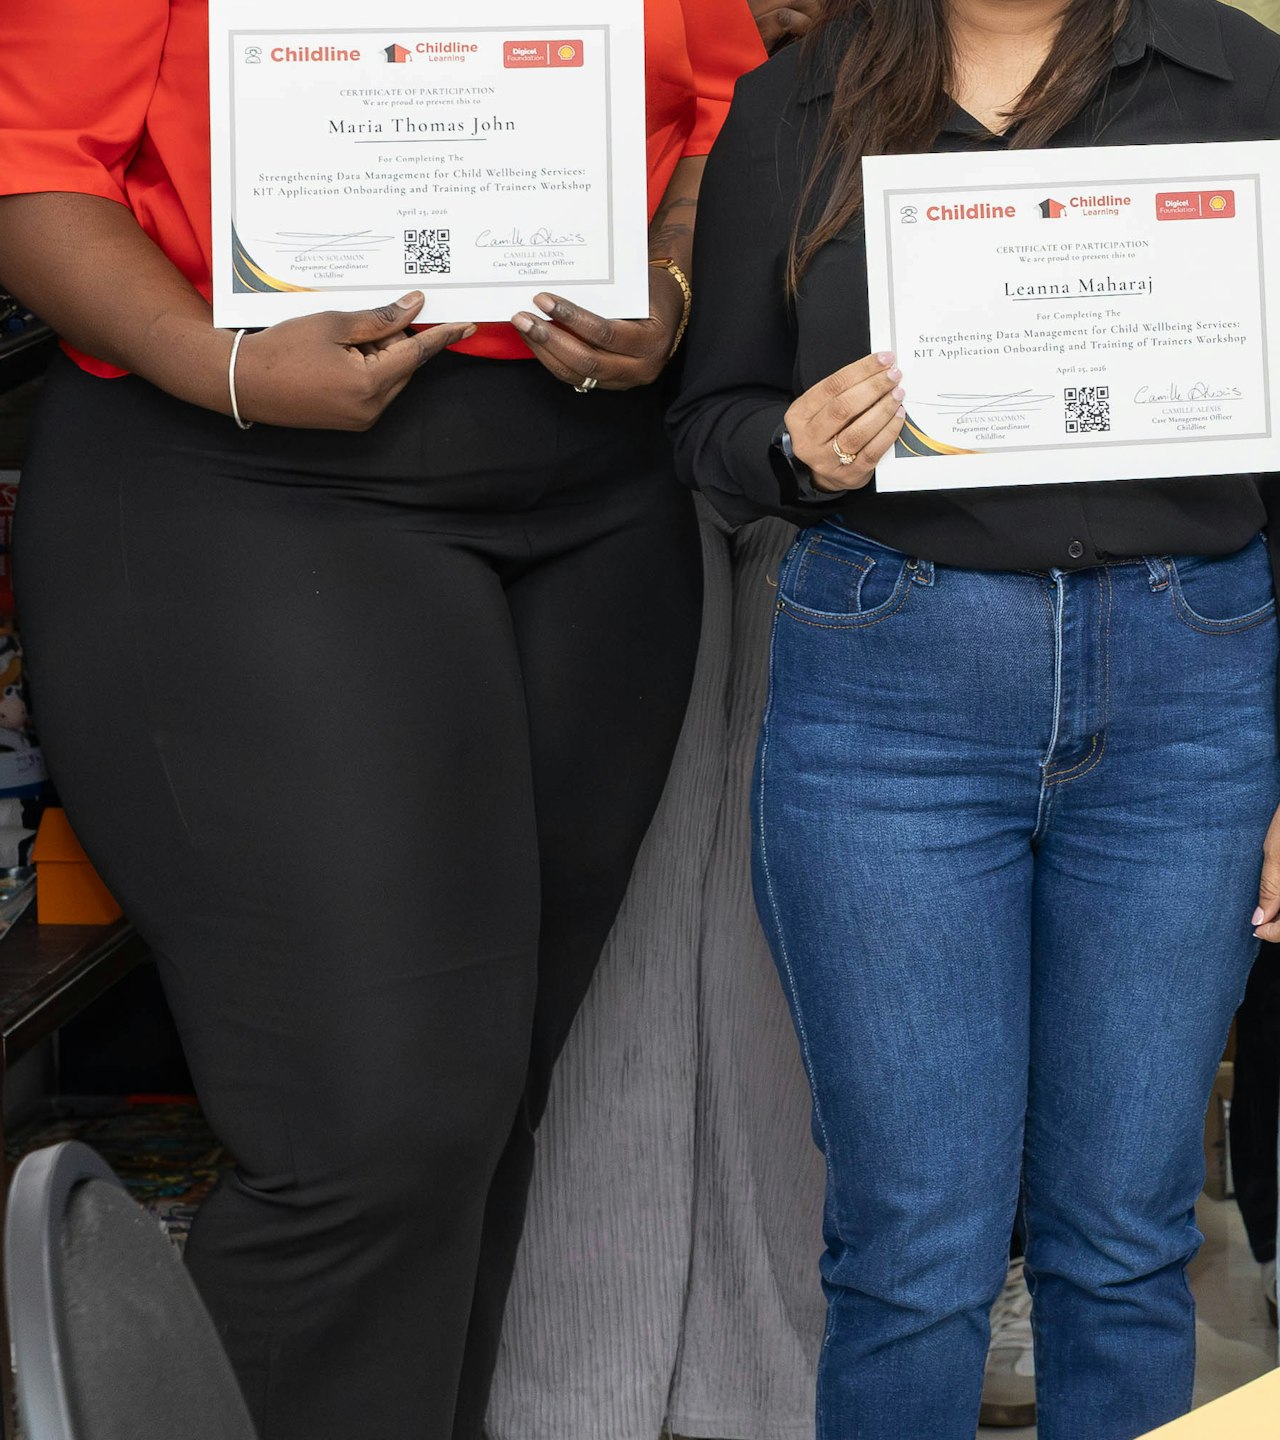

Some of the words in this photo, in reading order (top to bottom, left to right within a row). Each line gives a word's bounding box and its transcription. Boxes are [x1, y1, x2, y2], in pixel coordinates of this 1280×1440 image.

[415, 41, 478, 54] Childline
[512, 47, 537, 55] Digicel
[270, 46, 361, 63] Childline
[428, 54, 466, 63] Learning
[339, 88, 402, 97] CERTIFICATE
[404, 88, 416, 96] OF
[419, 87, 495, 96] PARTICIPATION
[329, 119, 382, 134] Maria
[391, 117, 464, 132] Thomas
[471, 115, 515, 136] John
[1069, 195, 1131, 208] Childline
[1165, 199, 1189, 208] Digicel
[926, 203, 1016, 221] Childline
[1082, 208, 1119, 216] Learning
[996, 244, 1058, 254] CERTIFICATE
[1060, 243, 1073, 251] OF
[1075, 240, 1149, 250] PARTICIPATION
[1005, 282, 1070, 296] Leanna
[1077, 274, 1152, 298] Maharaj
[919, 331, 993, 345] Strengthening
[996, 330, 1020, 339] Data
[1024, 329, 1088, 340] Management
[1092, 325, 1107, 335] for
[1110, 323, 1138, 334] Child
[1142, 322, 1193, 333] Wellbeing
[1196, 320, 1240, 330] Services:
[914, 348, 934, 358] KIT
[938, 346, 1000, 360] Application
[1003, 342, 1065, 354] Onboarding
[1068, 340, 1086, 351] and
[1090, 339, 1134, 351] Training
[1137, 337, 1149, 347] of
[1150, 337, 1193, 347] Trainers
[1196, 333, 1247, 345] Workshop
